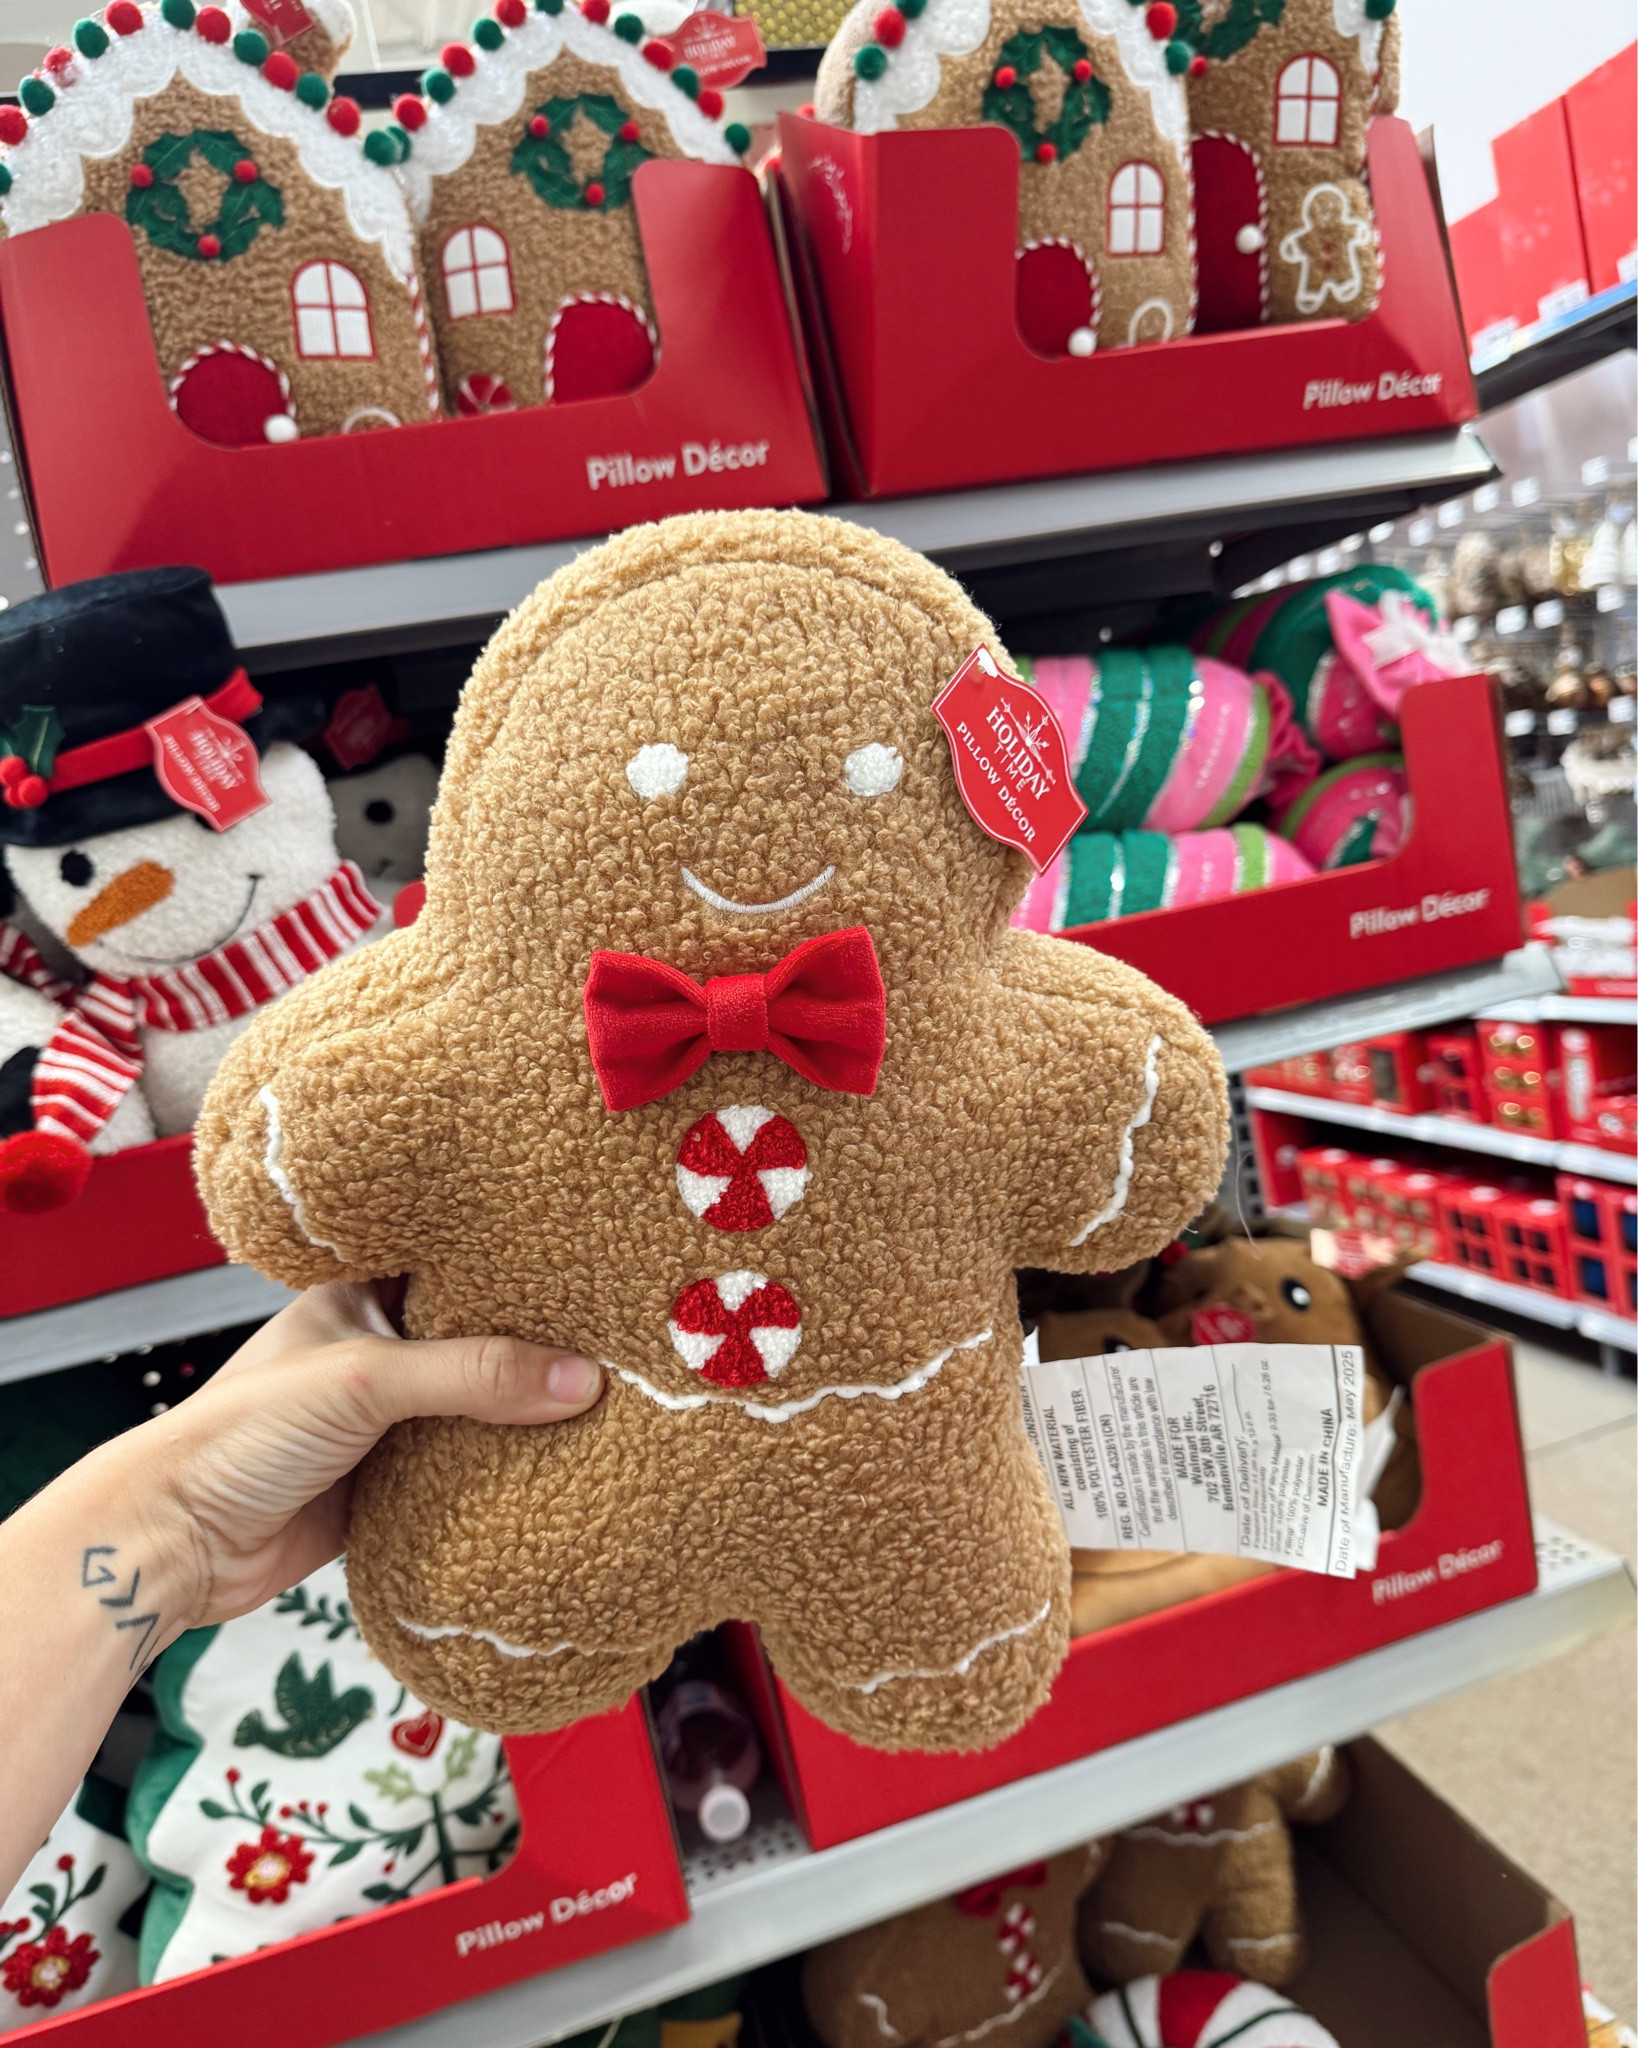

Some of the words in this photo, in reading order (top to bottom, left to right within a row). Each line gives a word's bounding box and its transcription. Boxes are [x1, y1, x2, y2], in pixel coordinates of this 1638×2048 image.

[1303, 376, 1375, 411] Pillow
[1378, 368, 1443, 401] Décor
[587, 454, 677, 492] Pillow
[684, 439, 770, 477] Décor
[986, 706, 1050, 800] HOLIDAY
[994, 744, 1026, 792] TIME
[956, 721, 1001, 785] PILLOW
[998, 787, 1036, 843] DÉCOR
[1350, 907, 1418, 939] Pillow
[1421, 888, 1491, 922] Décor
[1129, 1377, 1139, 1391] are
[1341, 1350, 1354, 1385] 2025
[1110, 1366, 1129, 1422] manufacturer
[1145, 1378, 1154, 1392] law
[1203, 1384, 1220, 1419] 72716
[1071, 1389, 1088, 1423] FIBER
[1130, 1393, 1144, 1419] article
[1146, 1394, 1158, 1412] with
[1345, 1389, 1356, 1419] May
[1043, 1406, 1064, 1460] MATERIAL
[1062, 1425, 1074, 1434] of
[1122, 1424, 1132, 1438] the
[1124, 1439, 1136, 1450] by
[1137, 1421, 1148, 1437] this
[1140, 1438, 1150, 1447] in
[1151, 1414, 1168, 1465] accordance
[1167, 1417, 1182, 1440] FOR
[1320, 1408, 1333, 1447] CHINA
[1067, 1438, 1087, 1490] consisting
[1078, 1425, 1101, 1488] POLYESTER
[1127, 1452, 1140, 1475] made
[1141, 1448, 1157, 1487] materials
[1172, 1445, 1188, 1478] MADE
[1185, 1436, 1203, 1485] Walmart
[1235, 1436, 1250, 1492] Delivery:
[1319, 1451, 1328, 1464] IN
[1340, 1425, 1356, 1514] Manufacture:
[1056, 1463, 1070, 1487] NEW
[1205, 1481, 1219, 1502] 702
[1268, 1466, 1278, 1491] Filling
[1279, 1458, 1290, 1497] polyester
[1287, 1498, 1297, 1522] 100%
[1292, 1456, 1303, 1496] polyester
[1317, 1470, 1328, 1506] MADE
[1062, 1491, 1075, 1510] ALL
[1092, 1490, 1108, 1518] 100%
[1134, 1485, 1151, 1536] Certification
[1150, 1489, 1160, 1504] the
[1160, 1477, 1178, 1520] described
[1240, 1496, 1250, 1510] of
[1151, 1506, 1163, 1523] that
[1241, 1514, 1250, 1546] Date
[1296, 1514, 1308, 1557] Exclusive
[1302, 1503, 1310, 1513] of
[1340, 1519, 1350, 1533] of
[1335, 1537, 1349, 1570] Date
[1372, 1565, 1435, 1606] Pillow
[1437, 1539, 1503, 1581] Décor
[455, 1913, 544, 1958] Pillow
[549, 1872, 638, 1925] Décor
